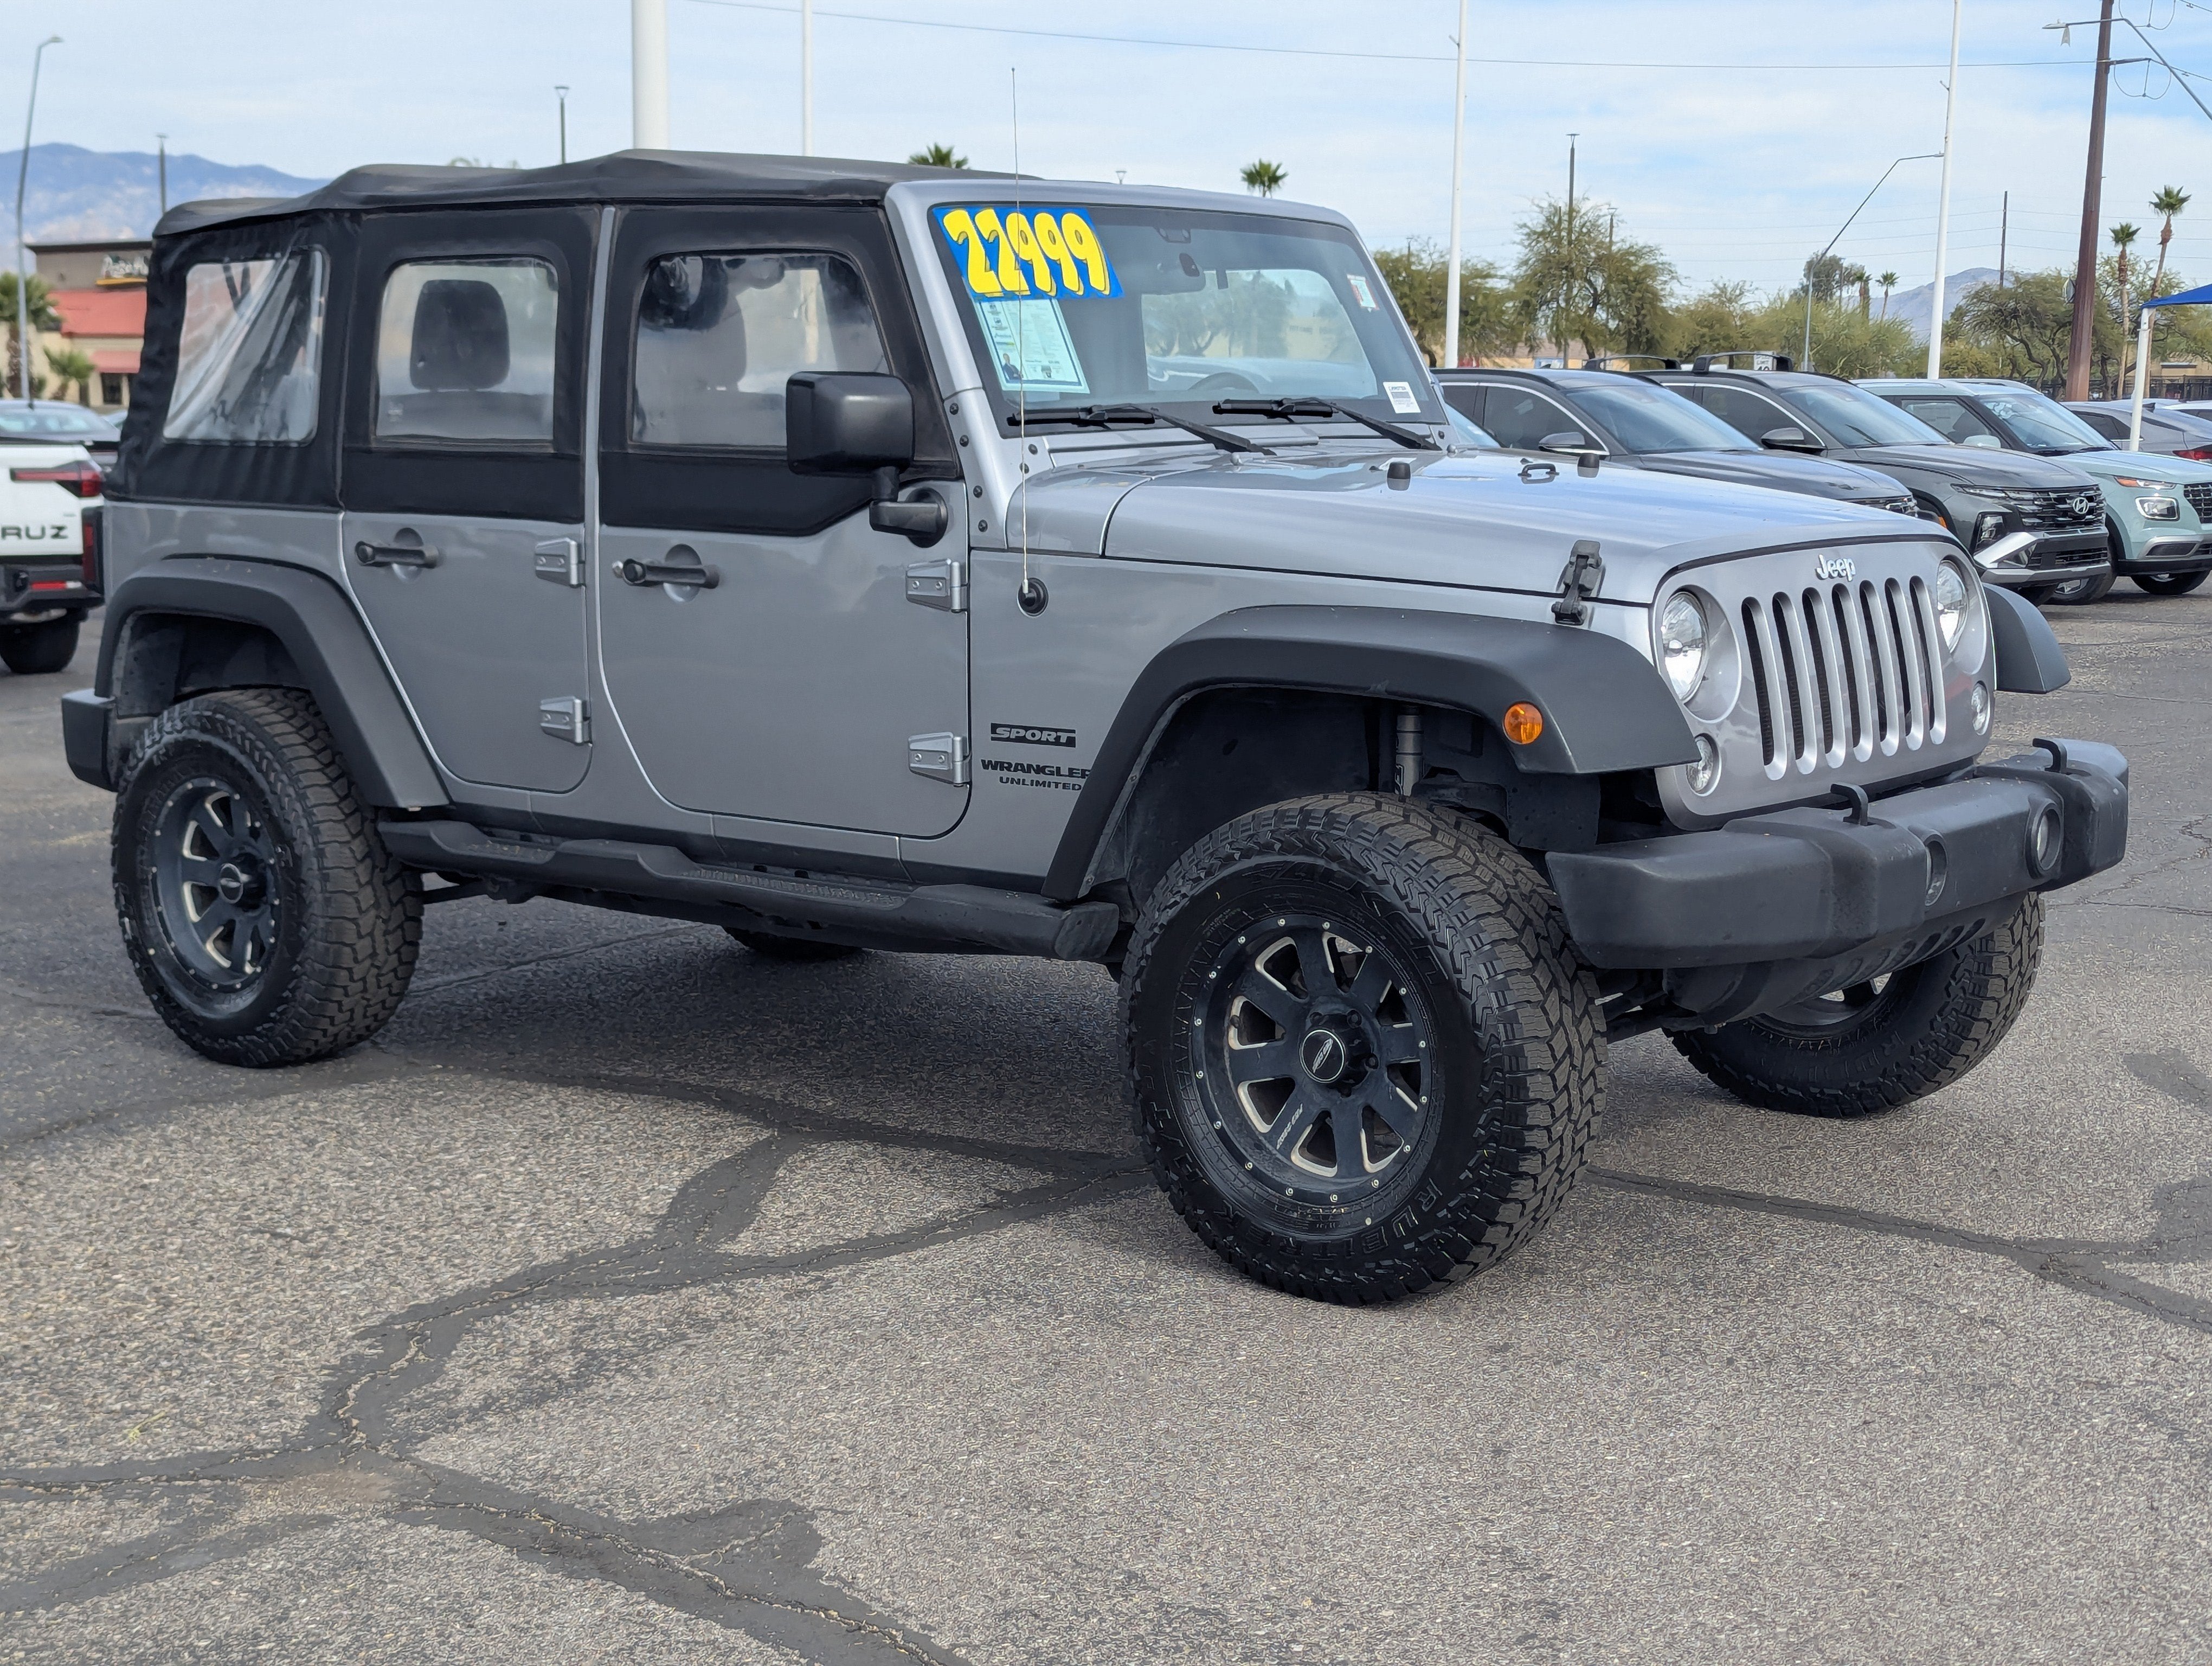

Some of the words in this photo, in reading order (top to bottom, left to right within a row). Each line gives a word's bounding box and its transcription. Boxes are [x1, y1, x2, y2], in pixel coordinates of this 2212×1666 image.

[943, 207, 1110, 298] 22999
[1816, 554, 1856, 582] Jeep
[991, 727, 1076, 743] SPORT
[999, 776, 1082, 791] UNLIMITED
